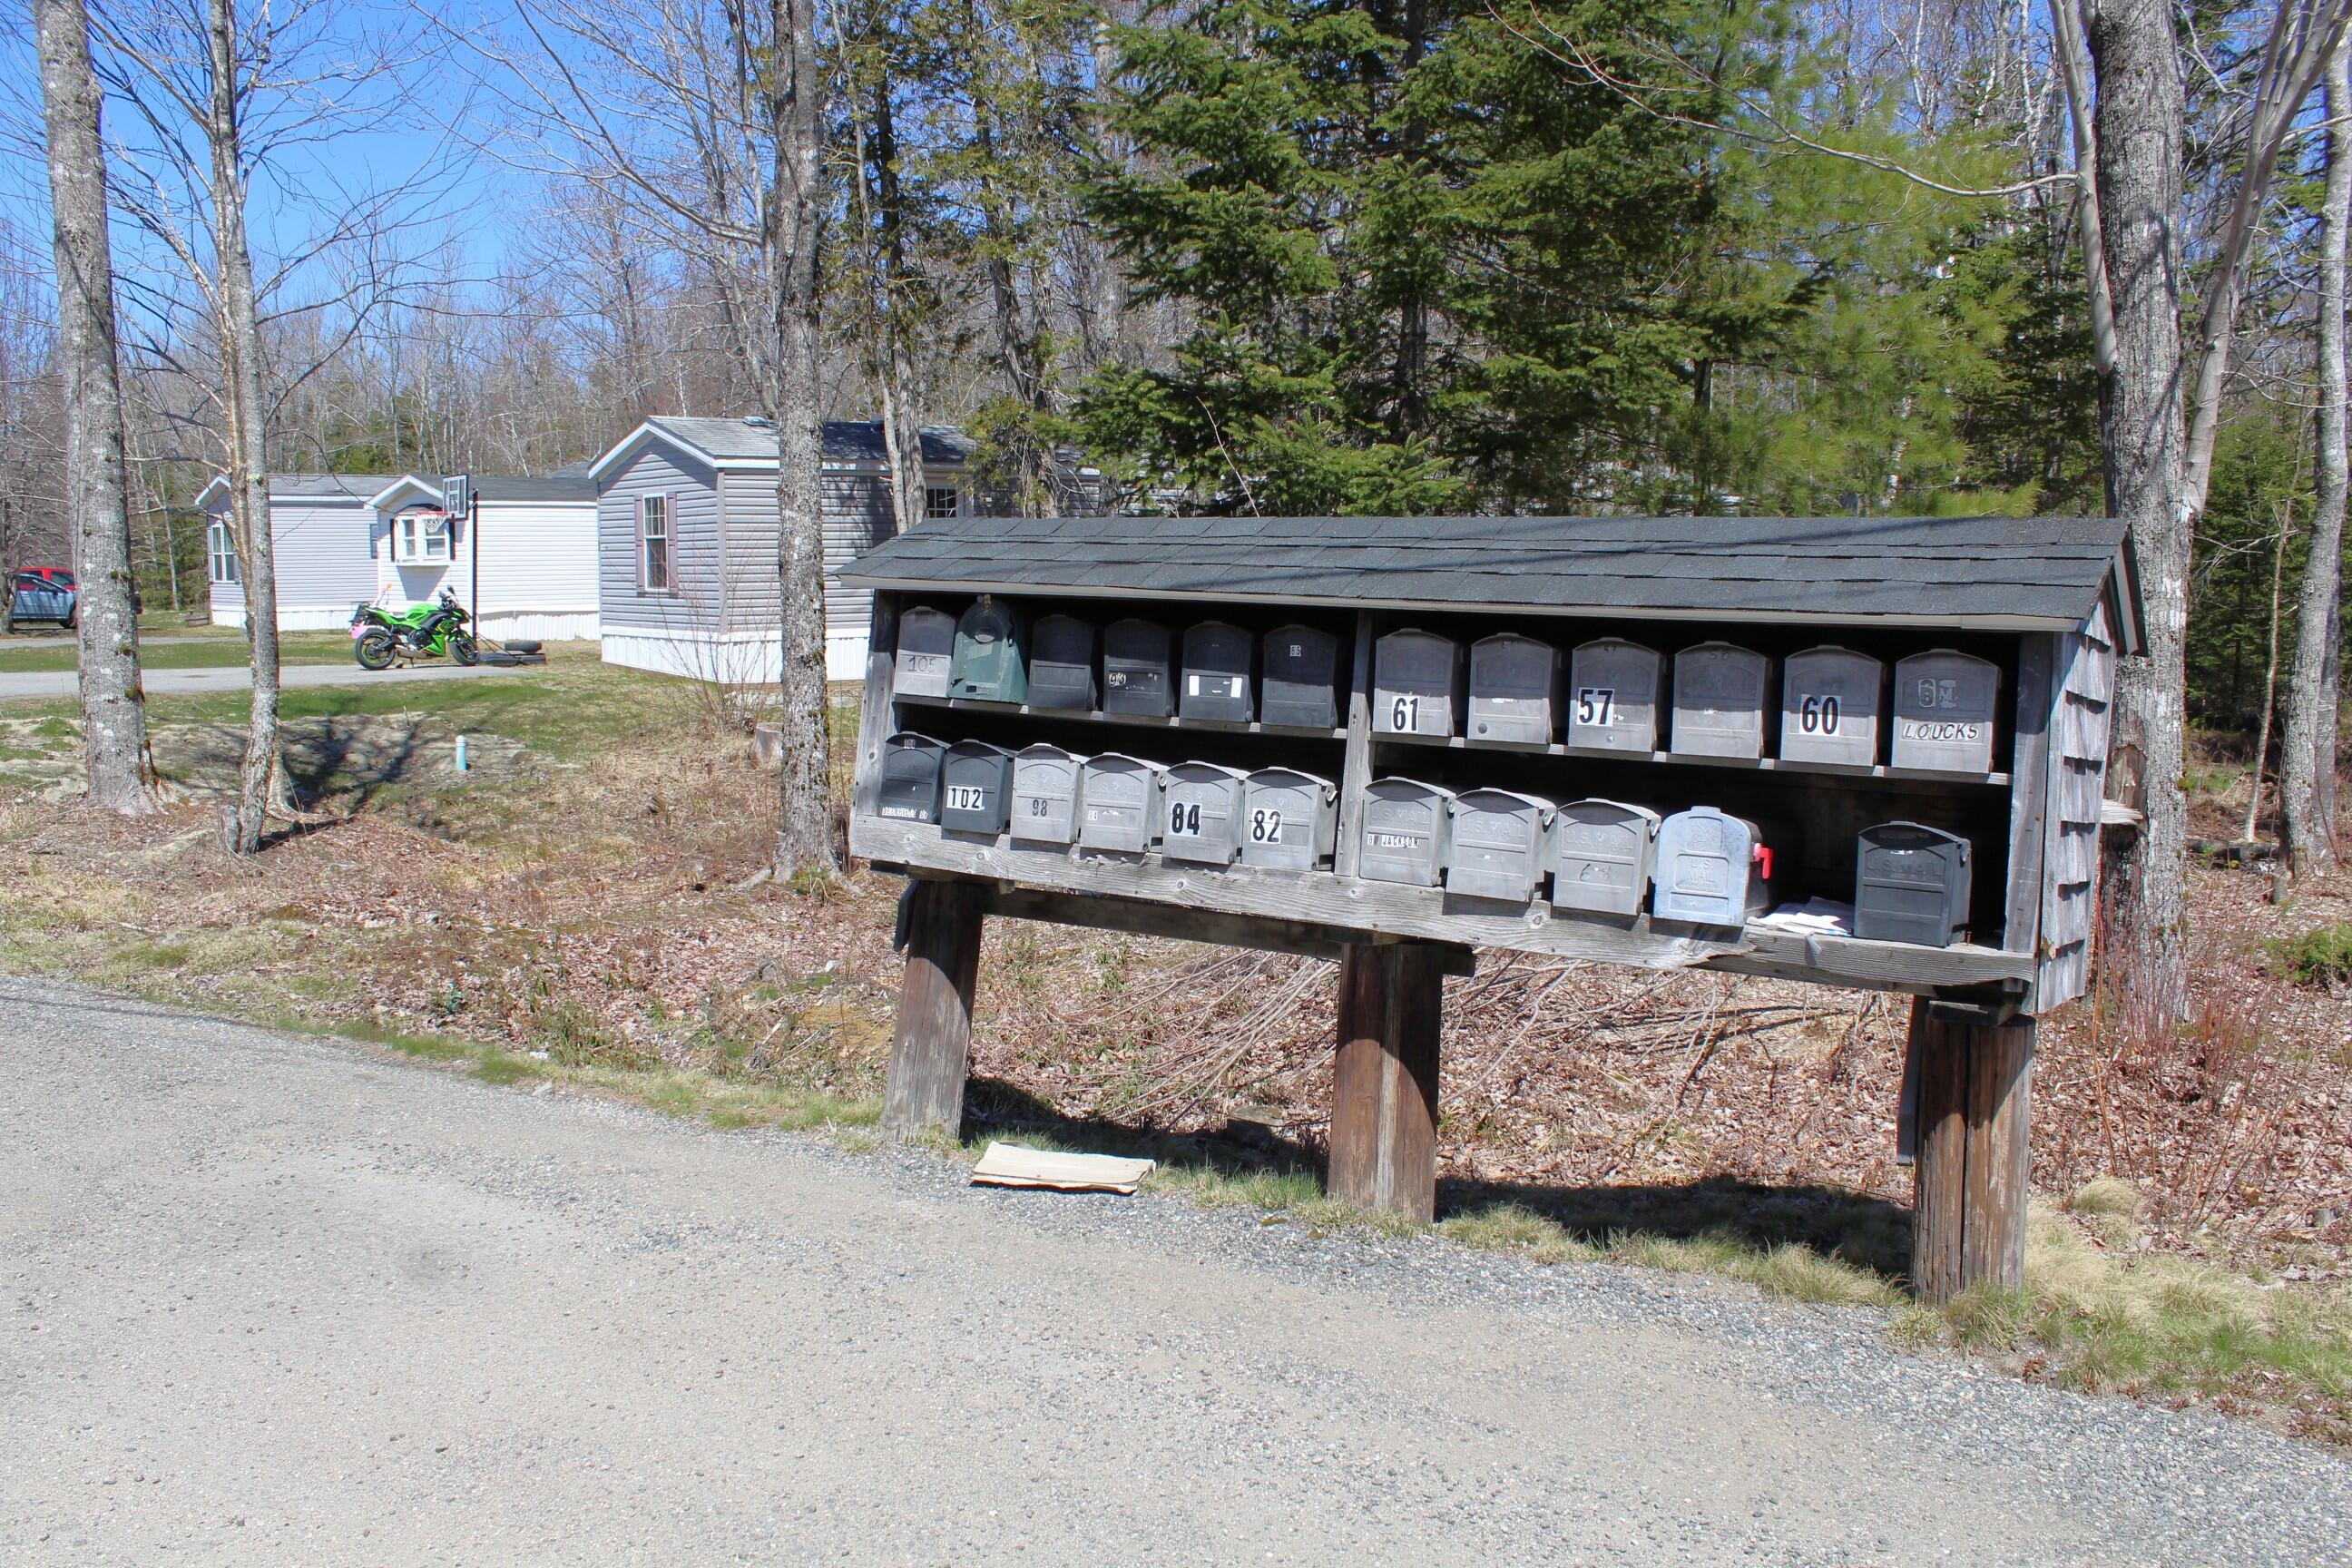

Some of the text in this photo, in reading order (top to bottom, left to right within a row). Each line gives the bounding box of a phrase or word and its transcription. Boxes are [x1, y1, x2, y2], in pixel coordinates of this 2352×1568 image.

[908, 656, 936, 672] 105
[1393, 697, 1419, 731] 61
[1579, 689, 1613, 725] 57
[1801, 696, 1839, 735] 60
[1905, 721, 1978, 740] LOUCKS
[951, 787, 981, 809] 102
[1032, 799, 1048, 817] 98
[1171, 802, 1200, 836] 84
[1251, 809, 1282, 843] 82
